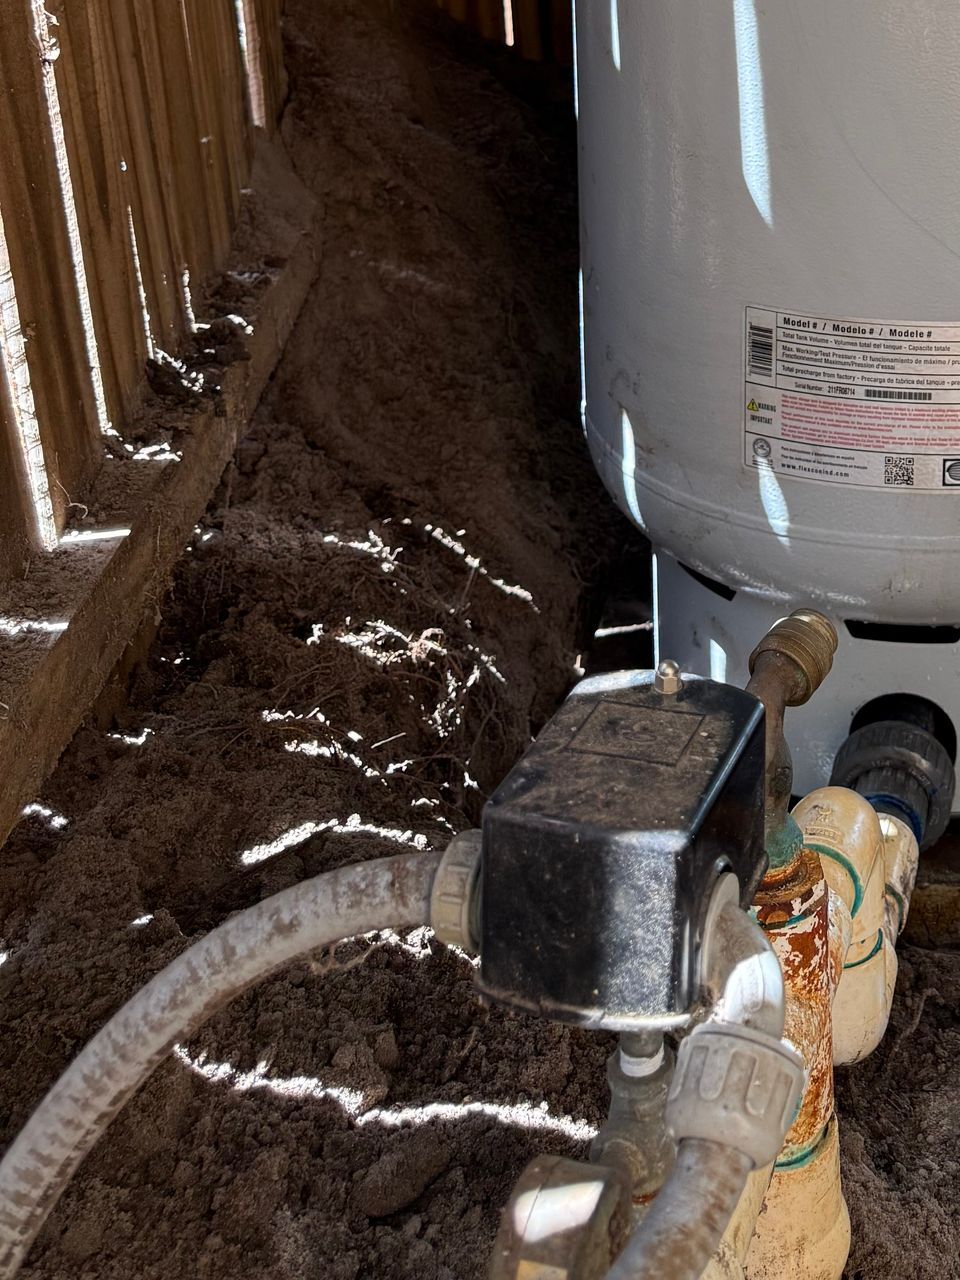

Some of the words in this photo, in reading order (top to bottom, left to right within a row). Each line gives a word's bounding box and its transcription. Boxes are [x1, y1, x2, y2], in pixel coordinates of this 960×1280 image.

[783, 317, 810, 329] Model
[822, 322, 827, 331] /
[832, 324, 867, 335] Modelo
[879, 328, 883, 336] /
[889, 329, 924, 338] Modele
[796, 333, 808, 341] Tank
[809, 335, 829, 344] Volume
[758, 402, 777, 413] WARNING
[750, 414, 773, 425] IMPORTANT
